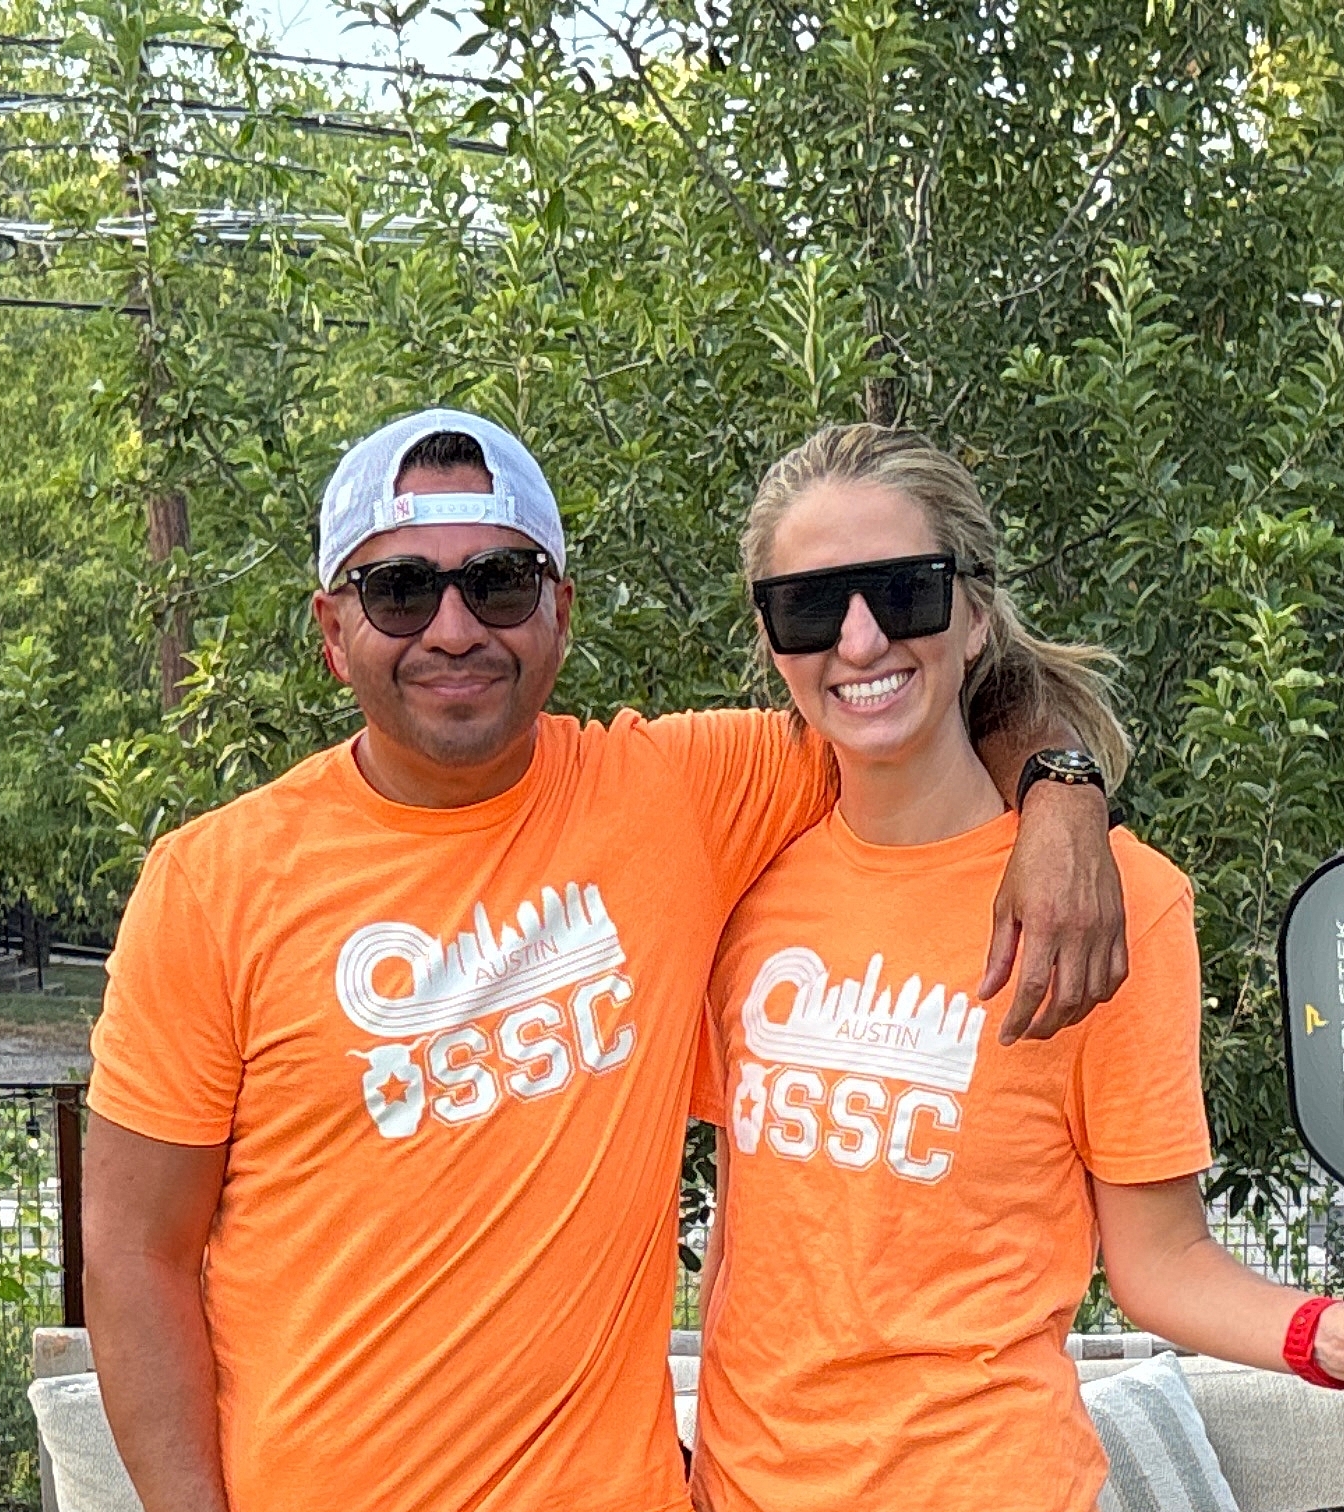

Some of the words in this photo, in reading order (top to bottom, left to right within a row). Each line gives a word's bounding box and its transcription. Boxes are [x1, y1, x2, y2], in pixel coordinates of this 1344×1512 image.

[475, 936, 559, 985] AUSTIN
[424, 968, 637, 1127] SSC
[835, 1018, 921, 1049] AUSTIN
[765, 1064, 963, 1186] SSC
